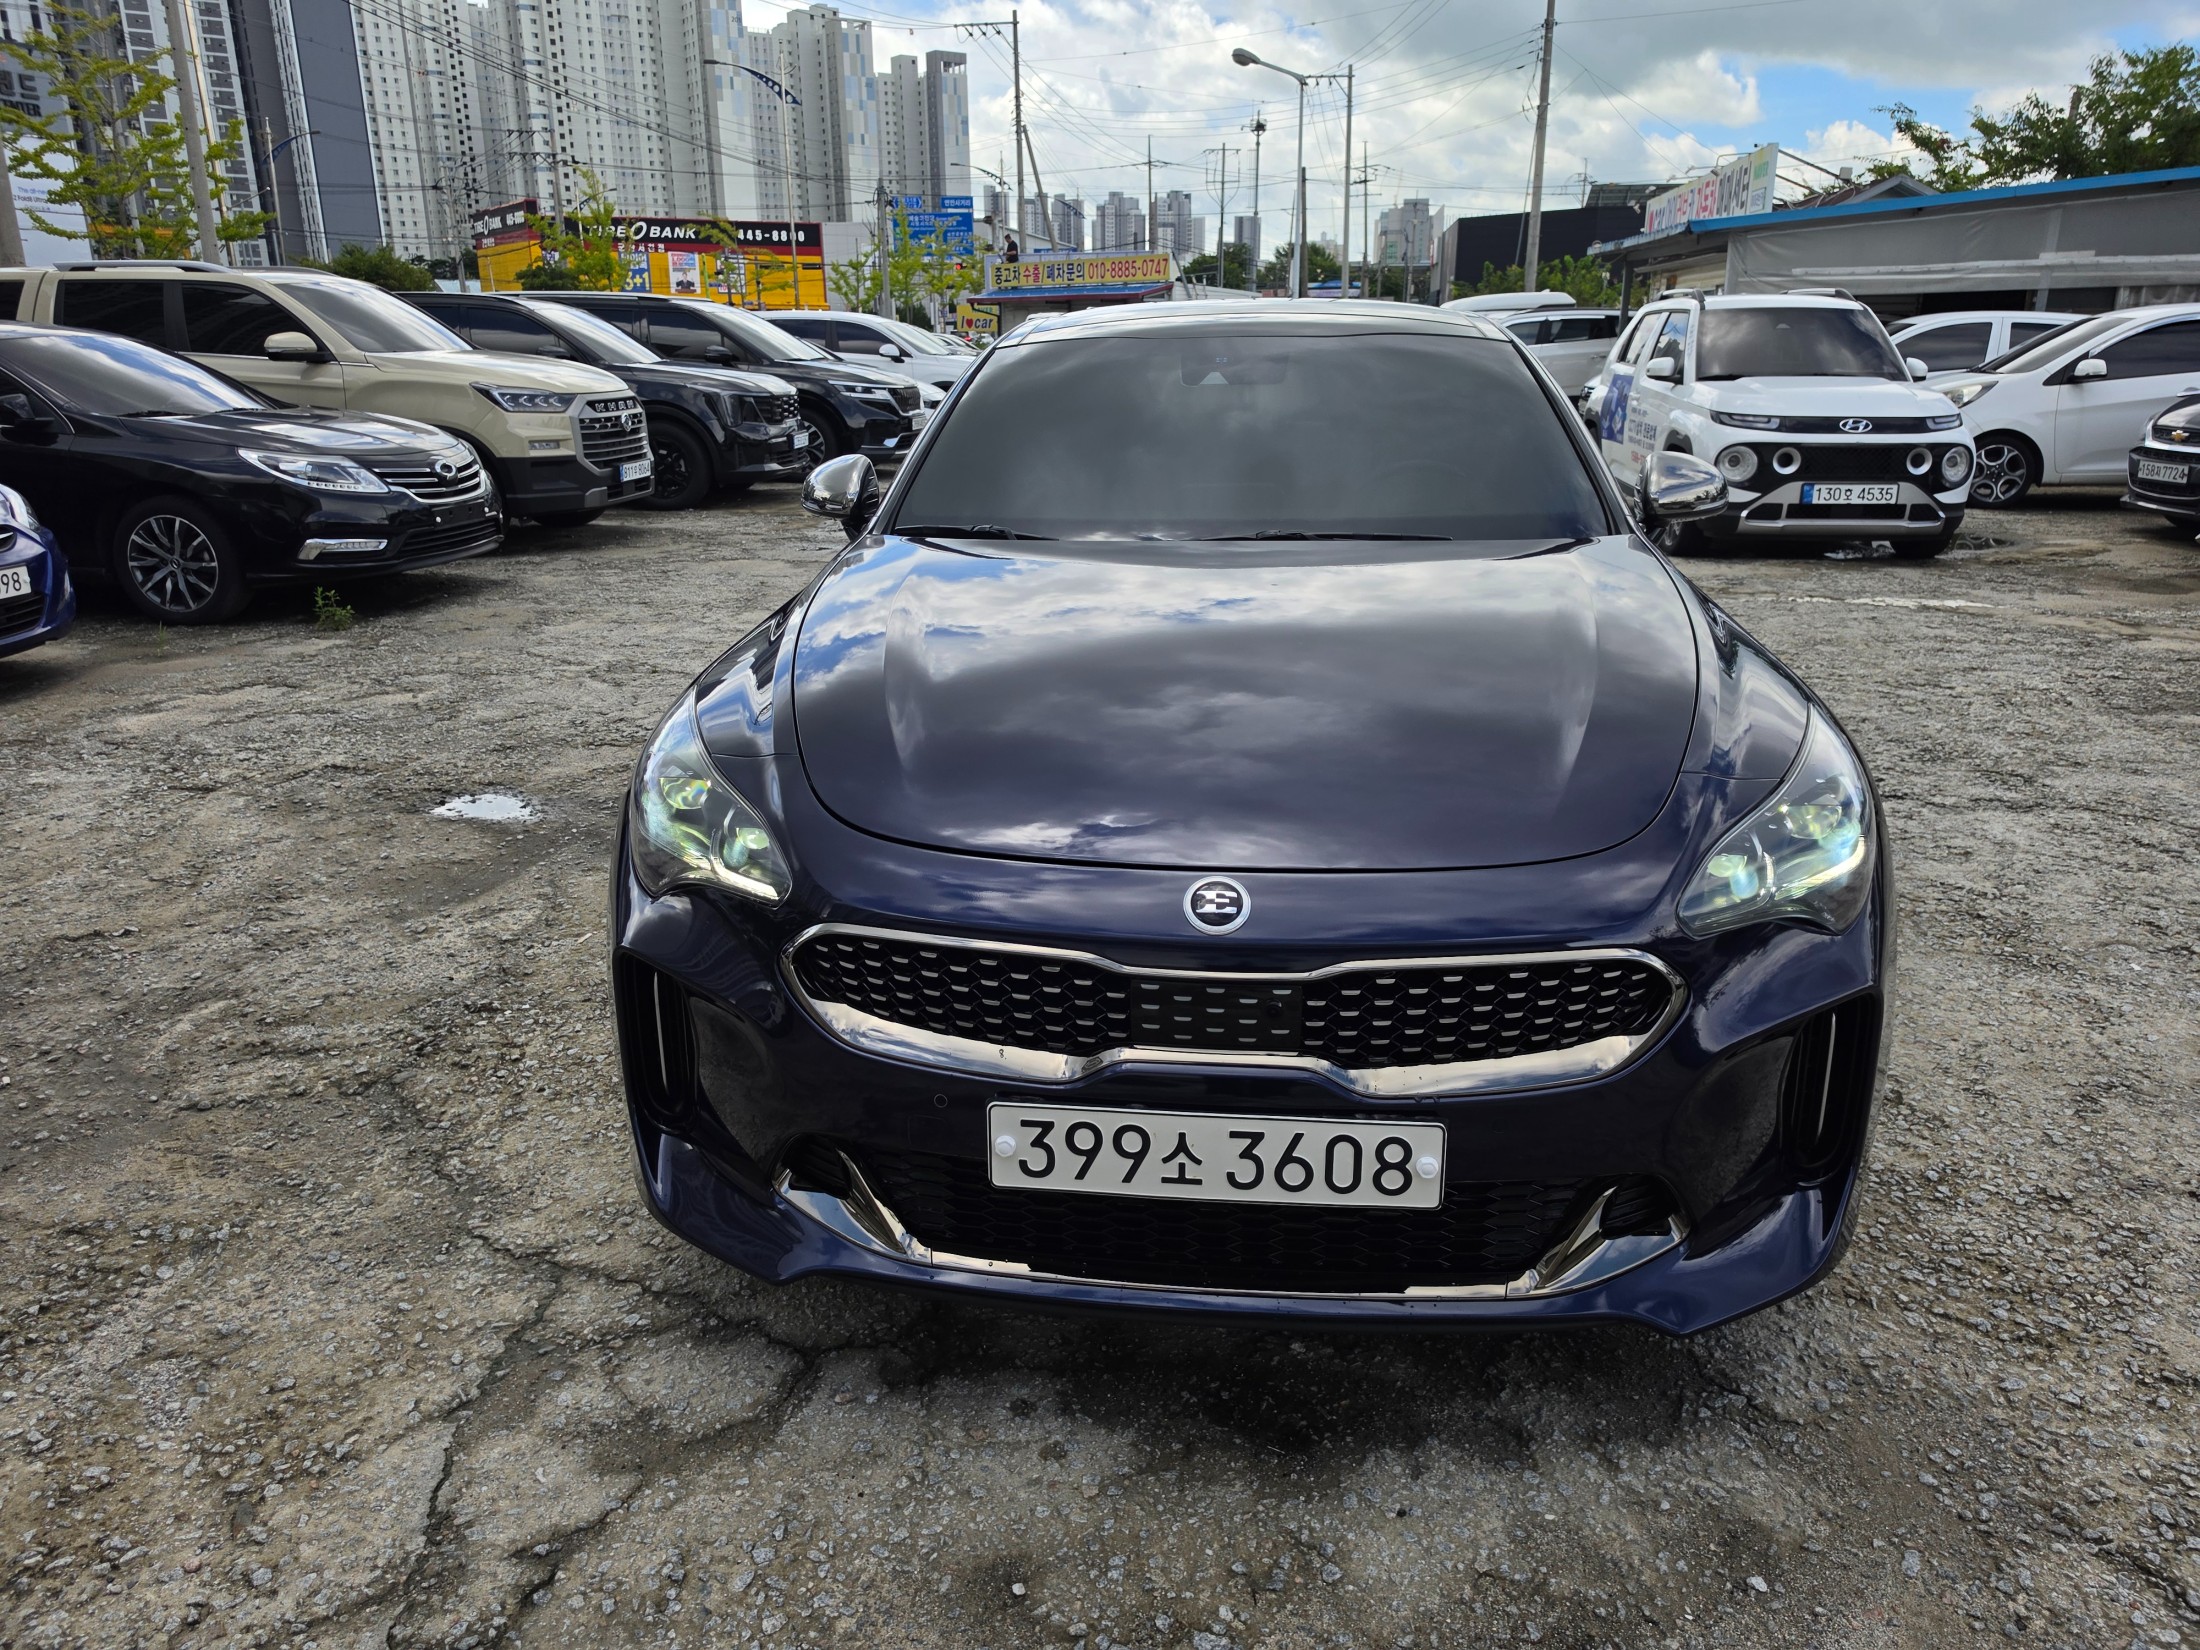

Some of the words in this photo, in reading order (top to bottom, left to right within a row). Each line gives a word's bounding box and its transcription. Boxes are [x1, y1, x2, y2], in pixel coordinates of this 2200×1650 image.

[649, 226, 697, 239] BANK
[995, 265, 1021, 285] 중고차
[974, 317, 993, 329] car
[595, 399, 635, 412] KHAN
[2162, 465, 2187, 481] 7724
[1815, 487, 1854, 502] 130호
[1857, 487, 1894, 502] 4535
[0, 571, 22, 595] 98
[1018, 1118, 1204, 1185] 399소
[1225, 1130, 1413, 1197] 3608
